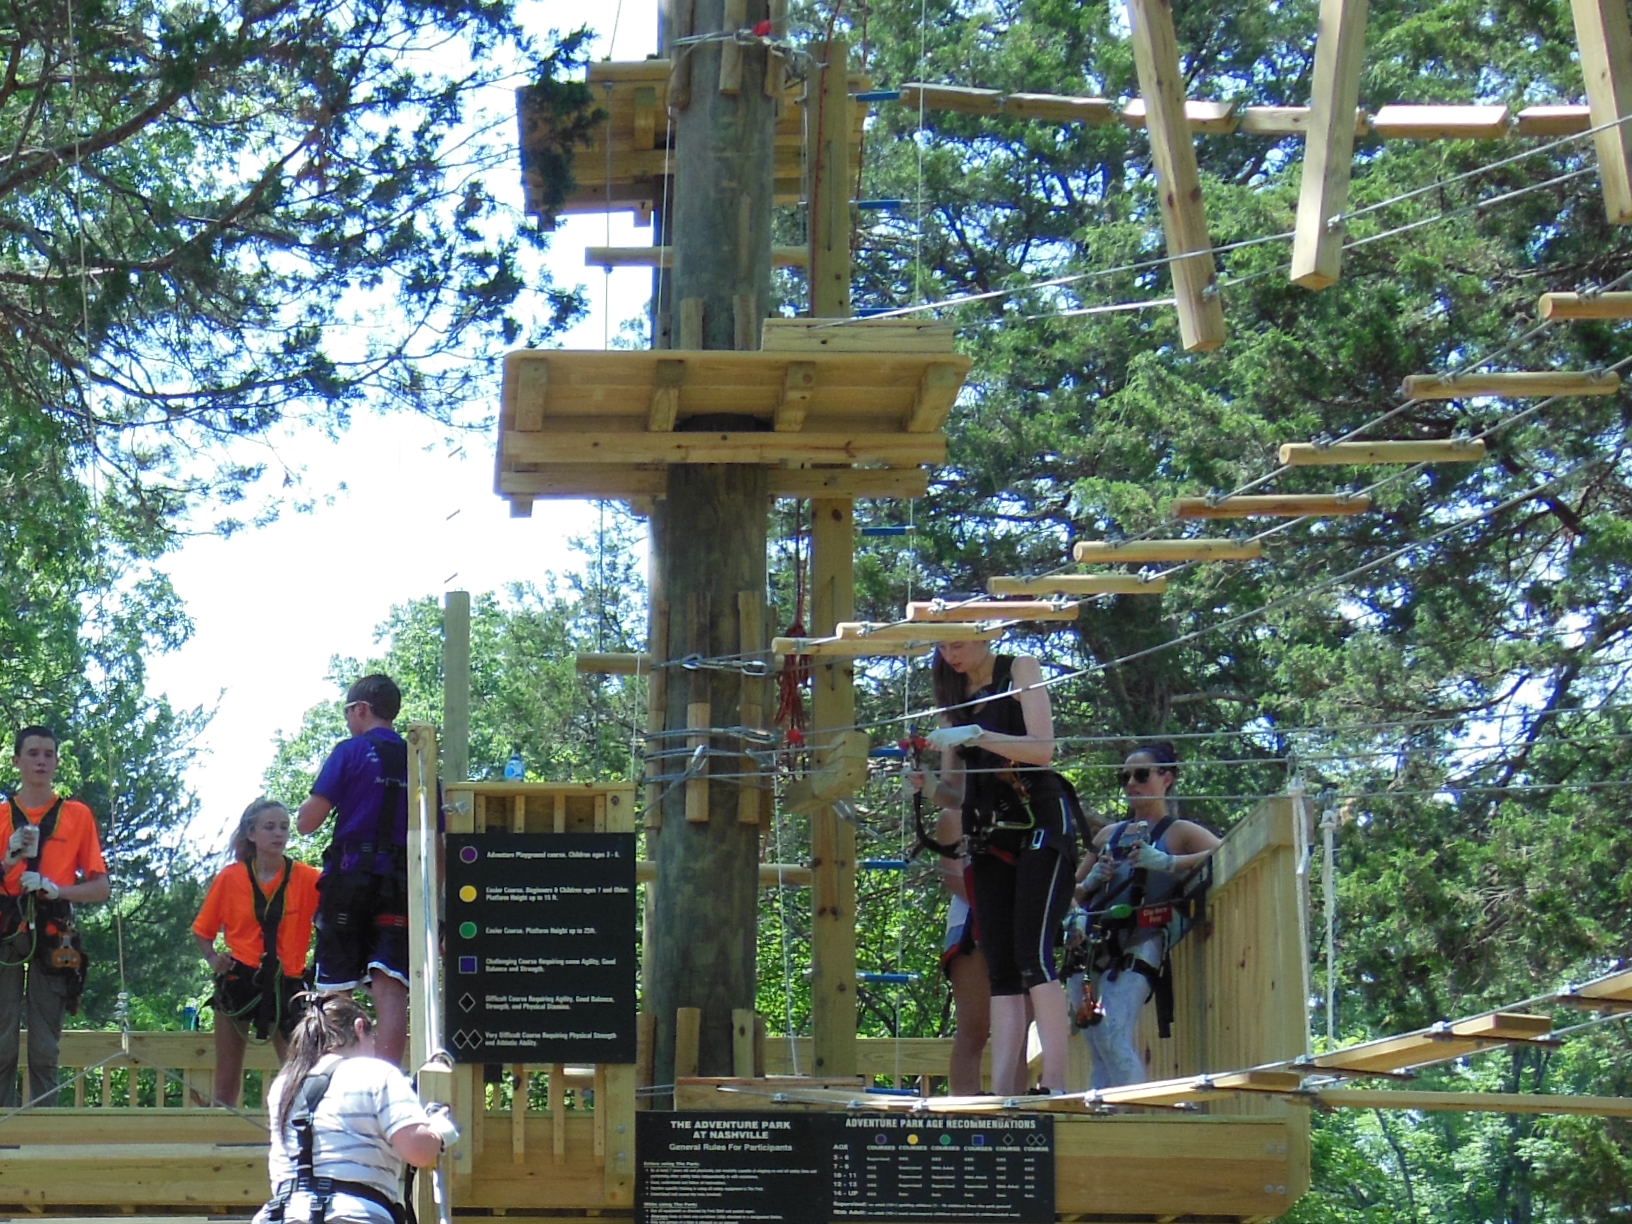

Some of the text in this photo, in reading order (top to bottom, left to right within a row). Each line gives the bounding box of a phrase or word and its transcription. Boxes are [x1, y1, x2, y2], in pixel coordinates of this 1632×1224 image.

[670, 1120, 791, 1130] THE ADVENTURE PARK
[845, 1118, 1036, 1129] ADVENTURE PARK AGE RECOMMENDATIONS
[692, 1130, 769, 1140] AT NASHVILLE
[702, 1143, 727, 1151] Rules
[728, 1143, 742, 1151] For
[744, 1143, 793, 1152] Participants
